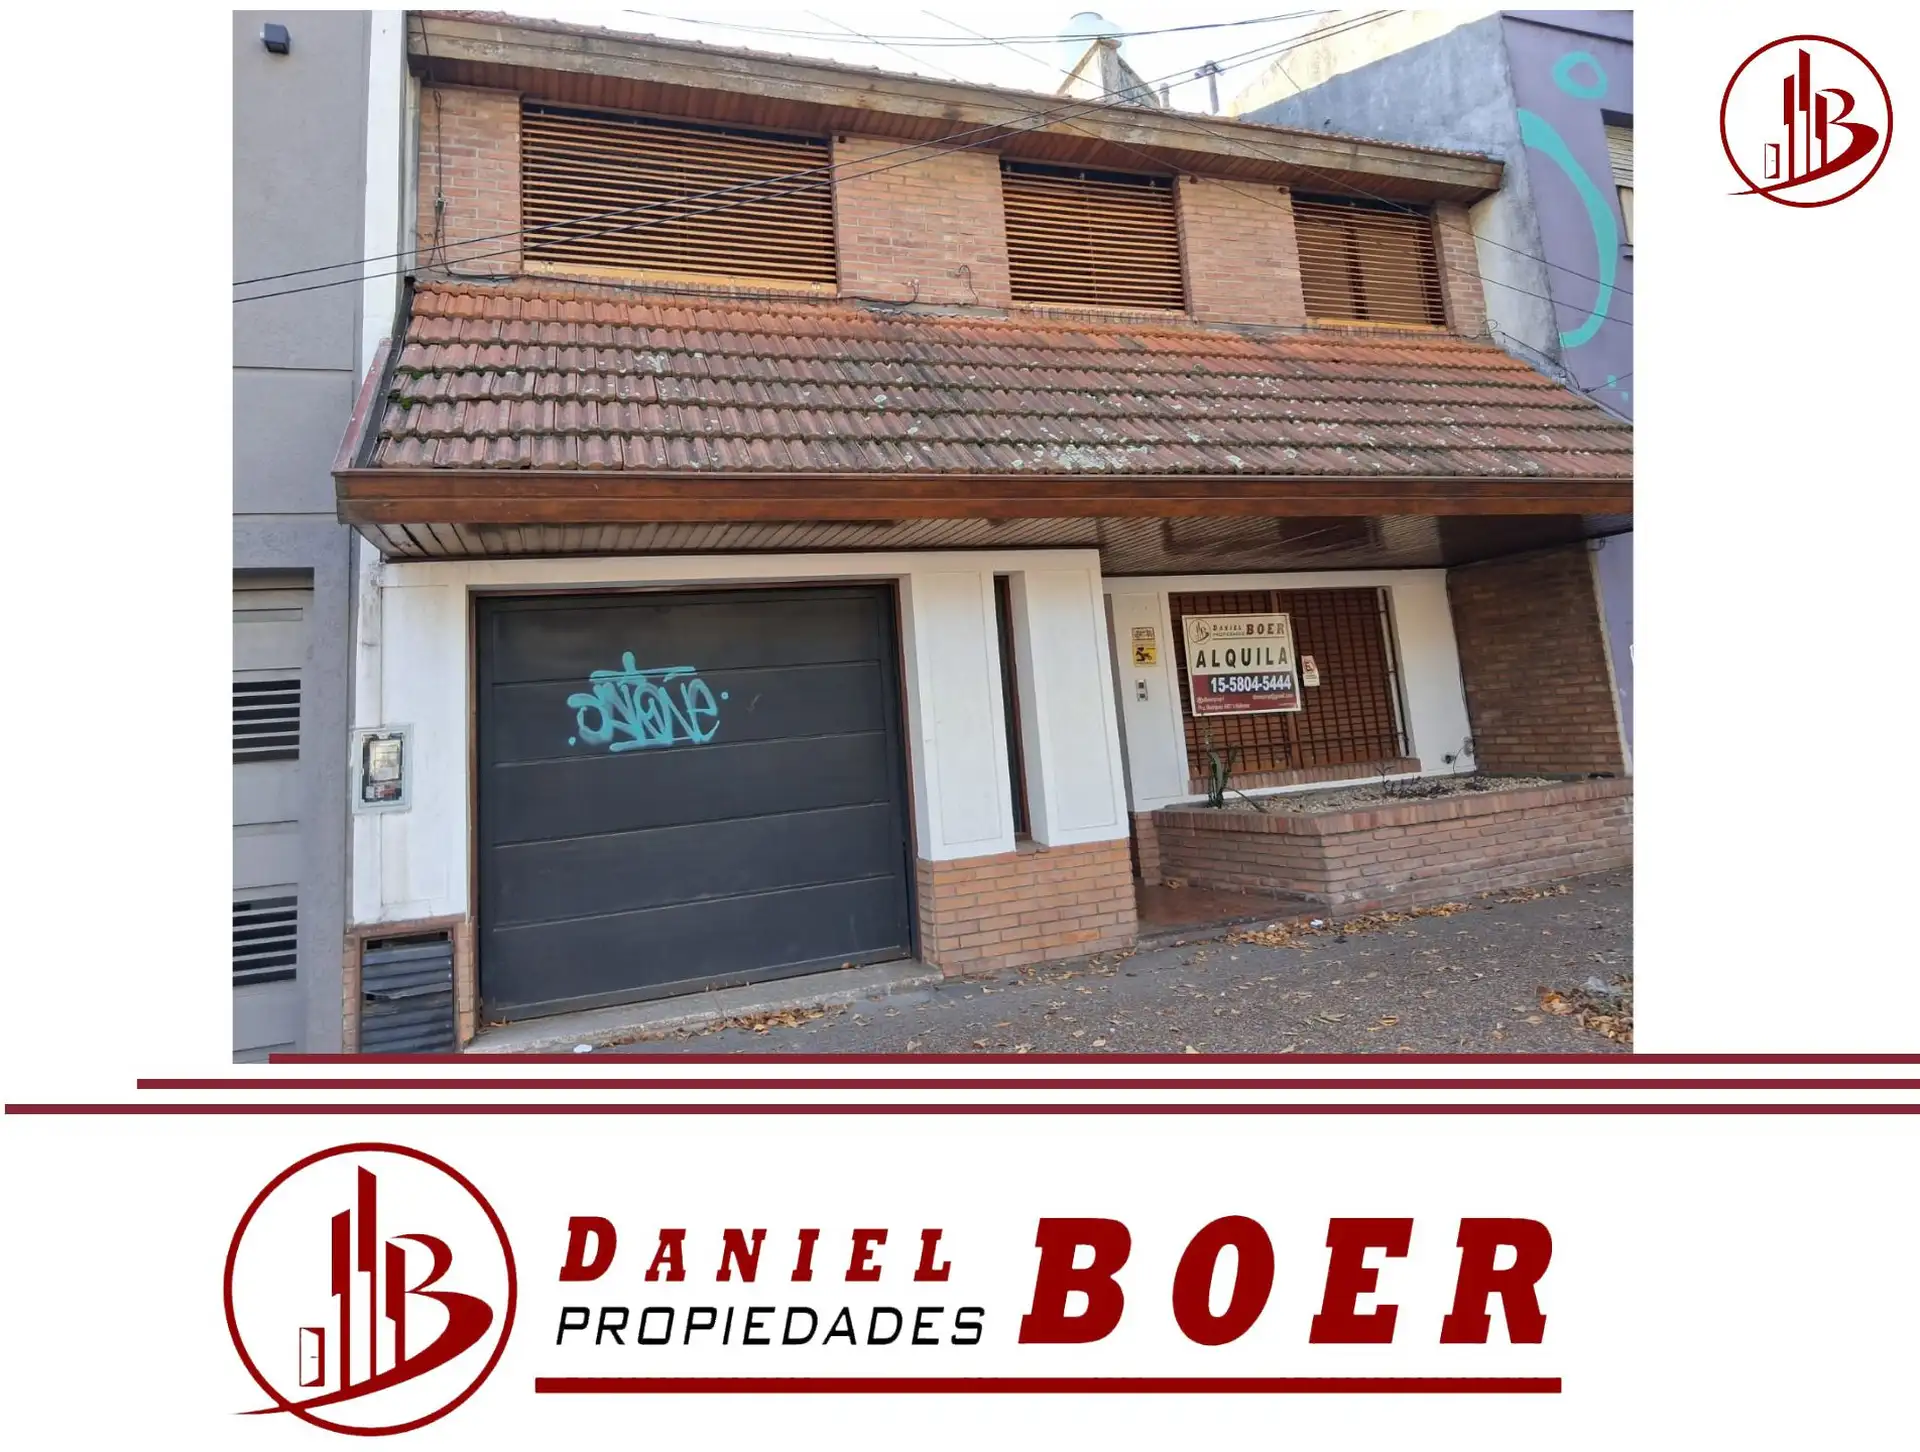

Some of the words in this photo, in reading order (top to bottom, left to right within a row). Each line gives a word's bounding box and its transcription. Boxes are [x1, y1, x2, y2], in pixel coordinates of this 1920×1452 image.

[1246, 623, 1285, 635] BOER
[1196, 646, 1288, 668] ALQUILA
[1211, 675, 1292, 693] 15-5804-5444
